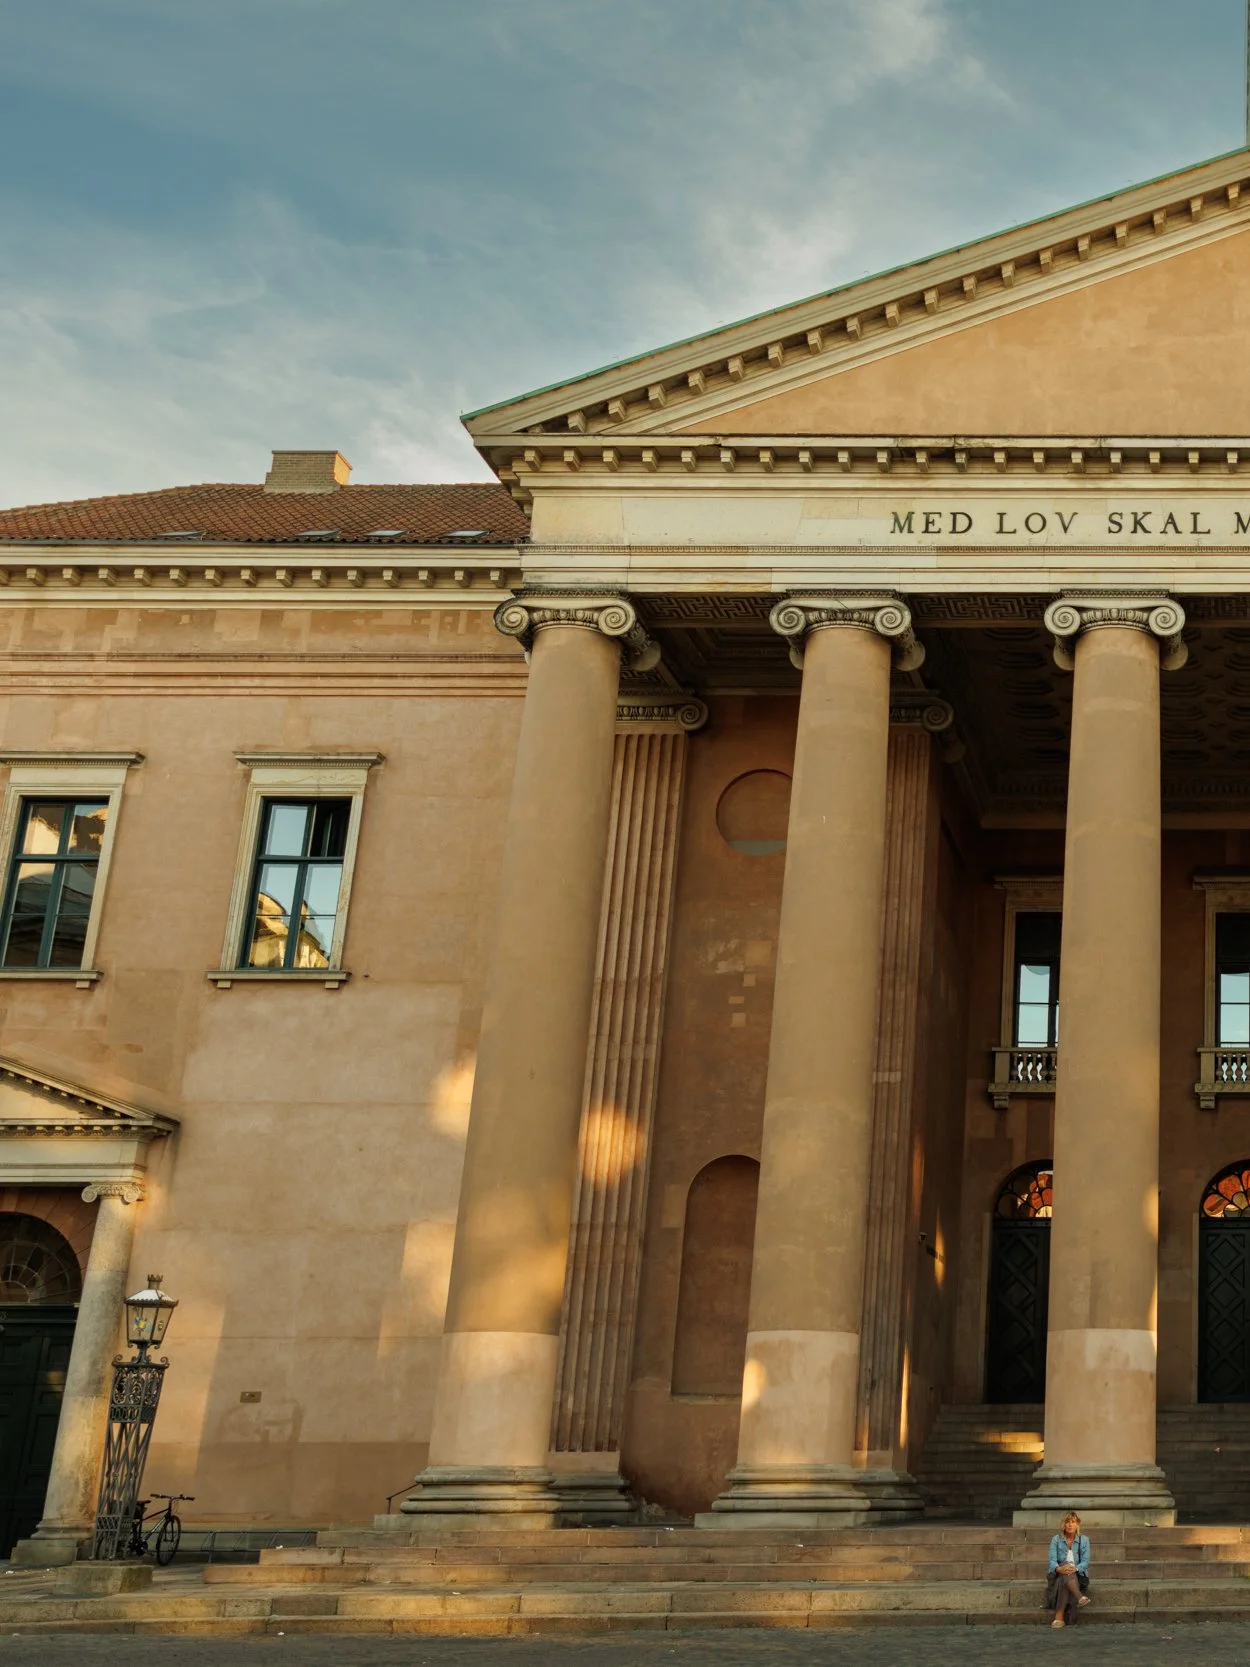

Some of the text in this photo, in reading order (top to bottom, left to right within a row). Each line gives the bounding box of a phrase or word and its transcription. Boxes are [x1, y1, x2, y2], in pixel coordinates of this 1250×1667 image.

[889, 511, 973, 535] MED
[996, 511, 1079, 535] LOV
[1107, 511, 1211, 535] SKAL
